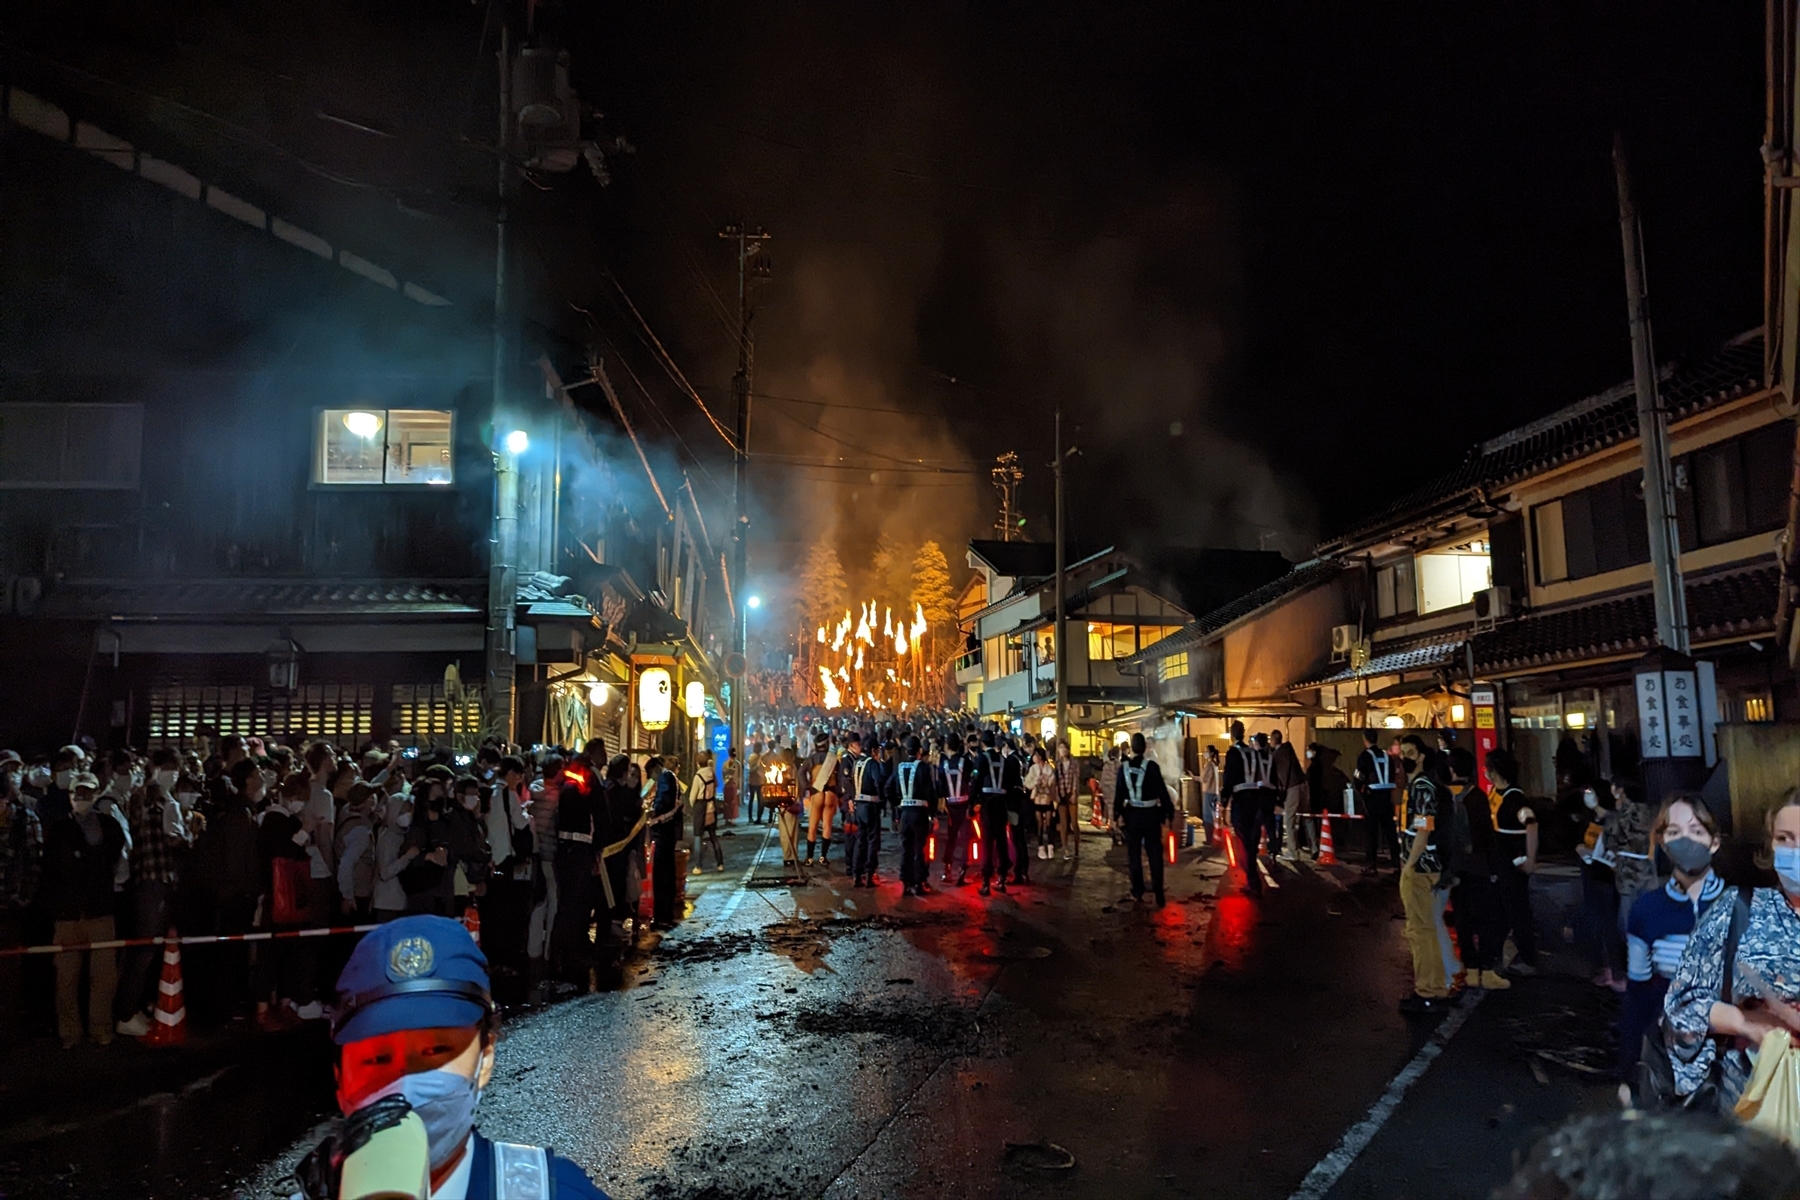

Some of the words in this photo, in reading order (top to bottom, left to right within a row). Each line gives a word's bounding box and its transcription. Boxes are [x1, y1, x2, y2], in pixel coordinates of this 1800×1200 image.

[1644, 679, 1661, 748] お食事処
[1674, 677, 1693, 748] お食事処
